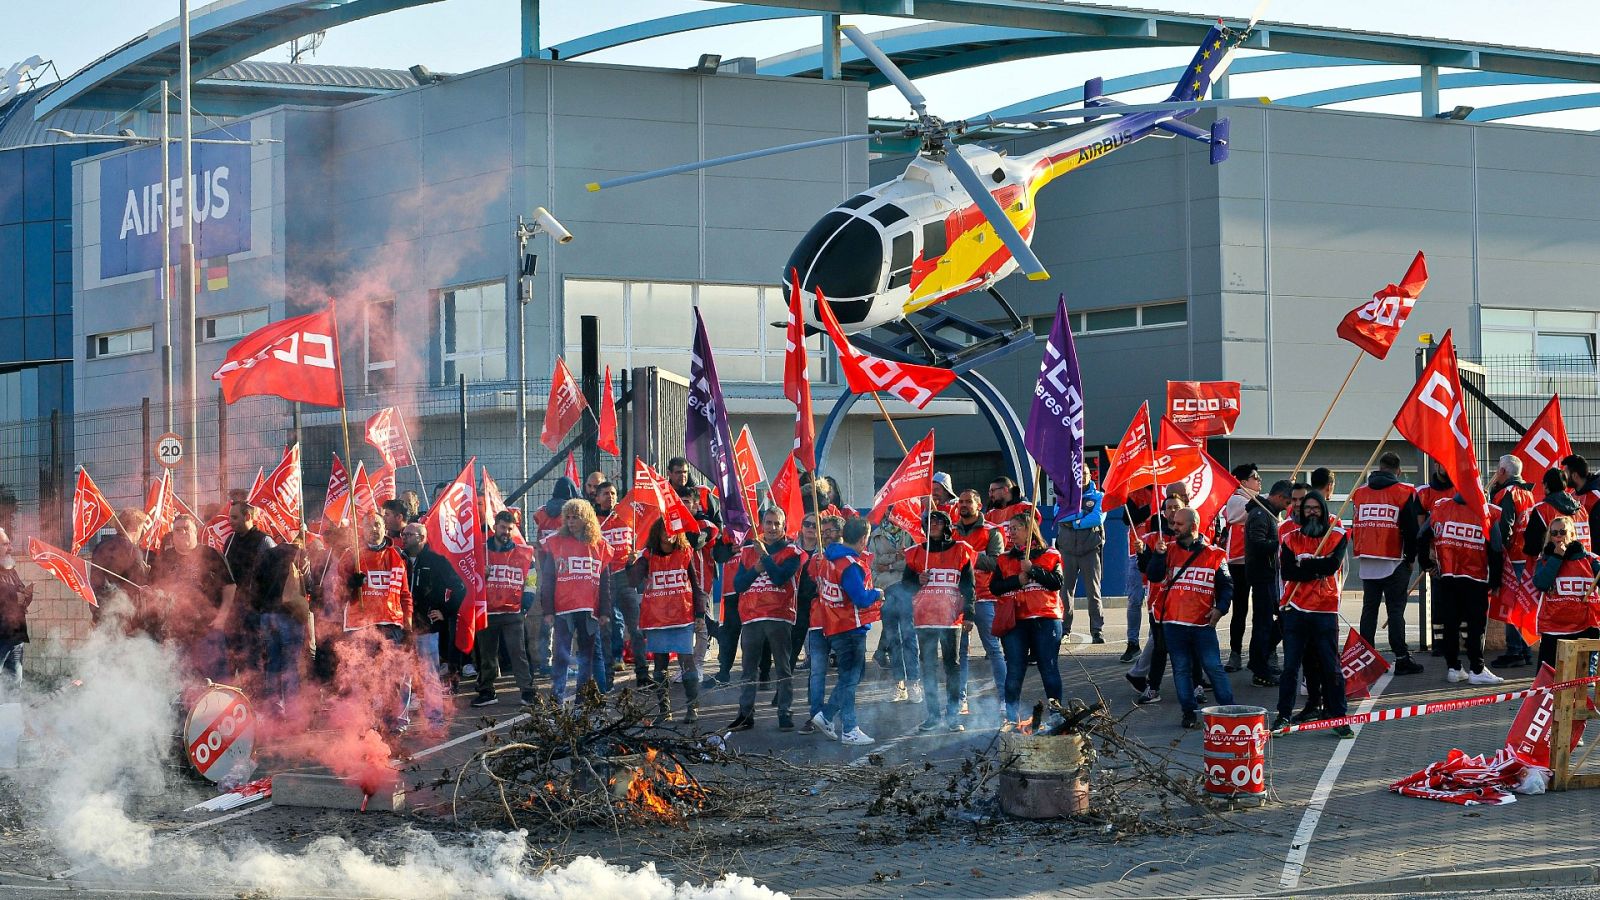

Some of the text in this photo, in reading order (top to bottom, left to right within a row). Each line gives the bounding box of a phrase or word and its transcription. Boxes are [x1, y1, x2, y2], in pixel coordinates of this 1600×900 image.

[1077, 129, 1133, 165] AIRBUS
[1173, 399, 1220, 411] CCOO
[161, 446, 180, 457] 20
[1362, 507, 1397, 518] CCOO
[1446, 524, 1483, 540] CCOO
